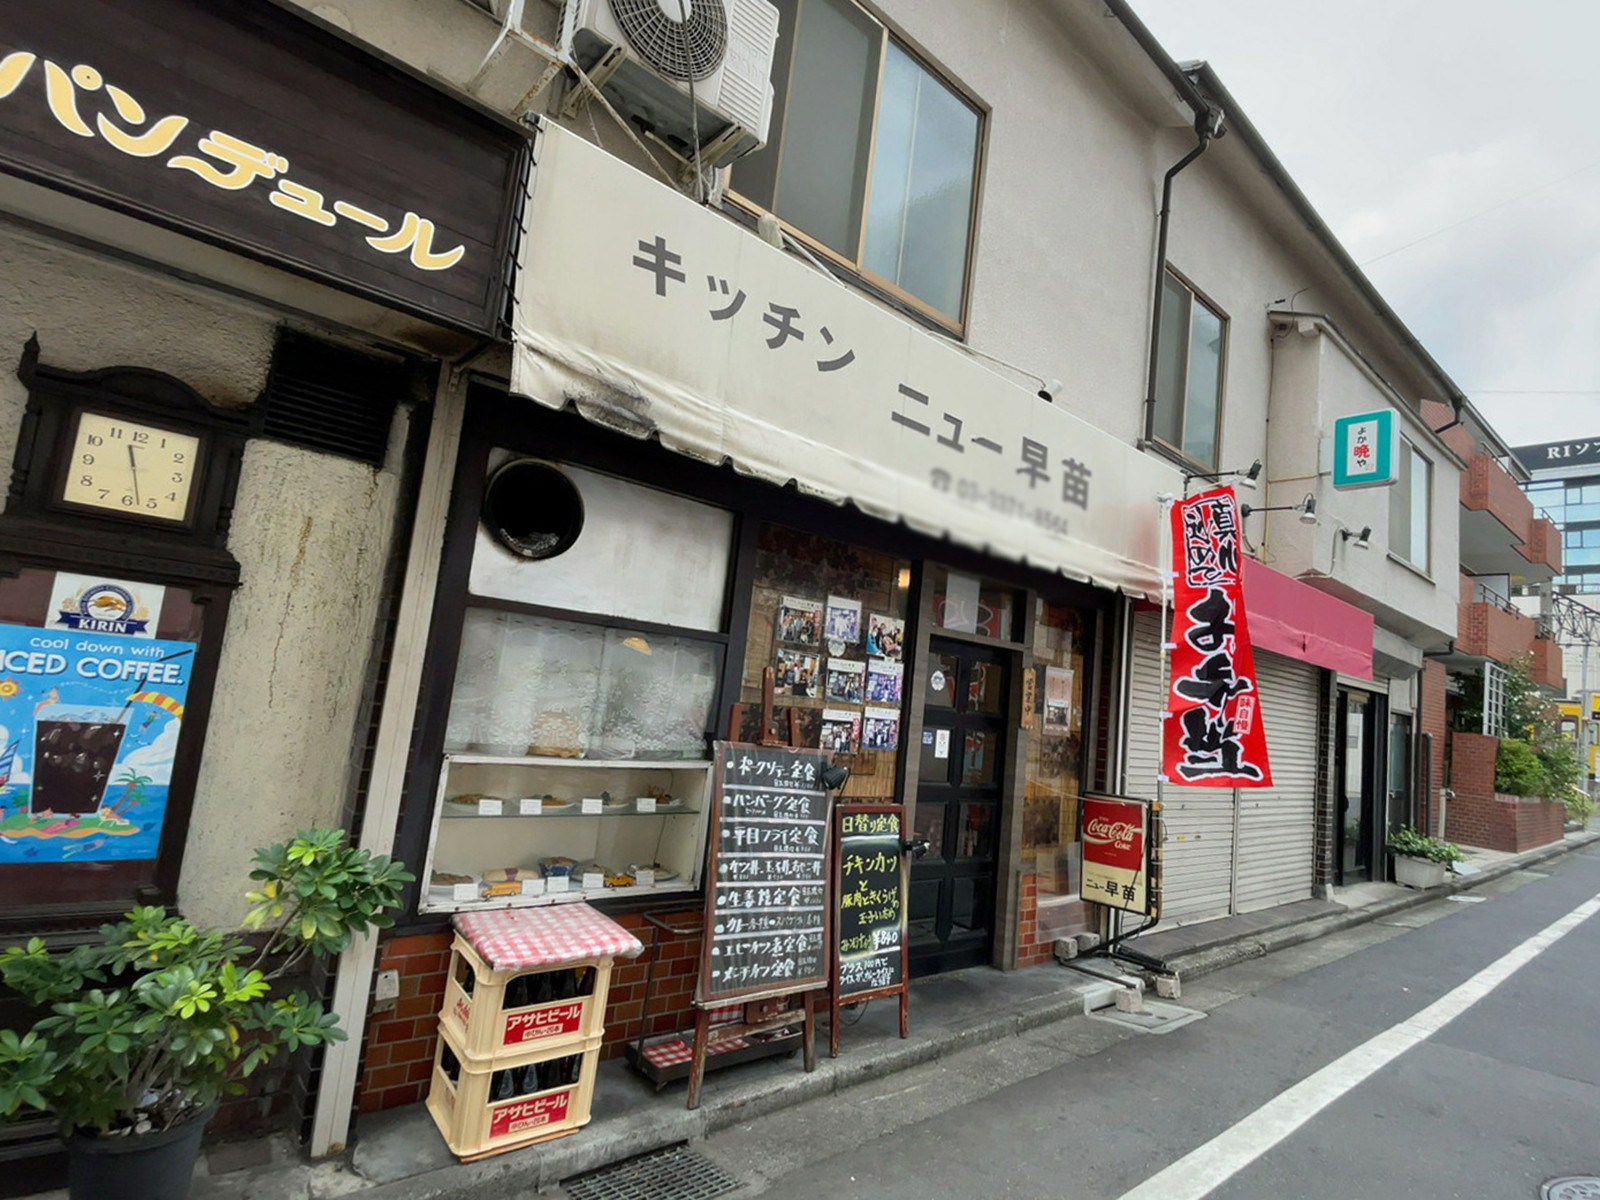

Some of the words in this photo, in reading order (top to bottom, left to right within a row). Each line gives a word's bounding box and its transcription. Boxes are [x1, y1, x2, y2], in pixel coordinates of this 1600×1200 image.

[0, 50, 466, 271] パンデュール
[632, 235, 856, 373] キッチン
[891, 383, 1092, 511] ニュー早苗
[110, 427, 123, 440] 11
[132, 431, 149, 444] 12
[87, 434, 104, 447] 10
[160, 438, 167, 449] 1
[82, 454, 95, 466] 9
[173, 452, 185, 464] 2
[80, 473, 93, 487] 8
[171, 472, 183, 484] 3
[98, 488, 110, 500] 7
[165, 491, 176, 502] 4
[121, 494, 134, 508] 6
[145, 497, 158, 510] 5
[79, 618, 127, 633] KIRIN
[29, 636, 69, 650] cool
[76, 639, 123, 655] down
[130, 644, 165, 658] with
[843, 852, 897, 876] チキンカツ
[859, 880, 868, 891] と
[1085, 880, 1136, 902] ニュー早苗
[507, 1005, 581, 1031] アサヒビール
[493, 1094, 568, 1124] アサヒビール
